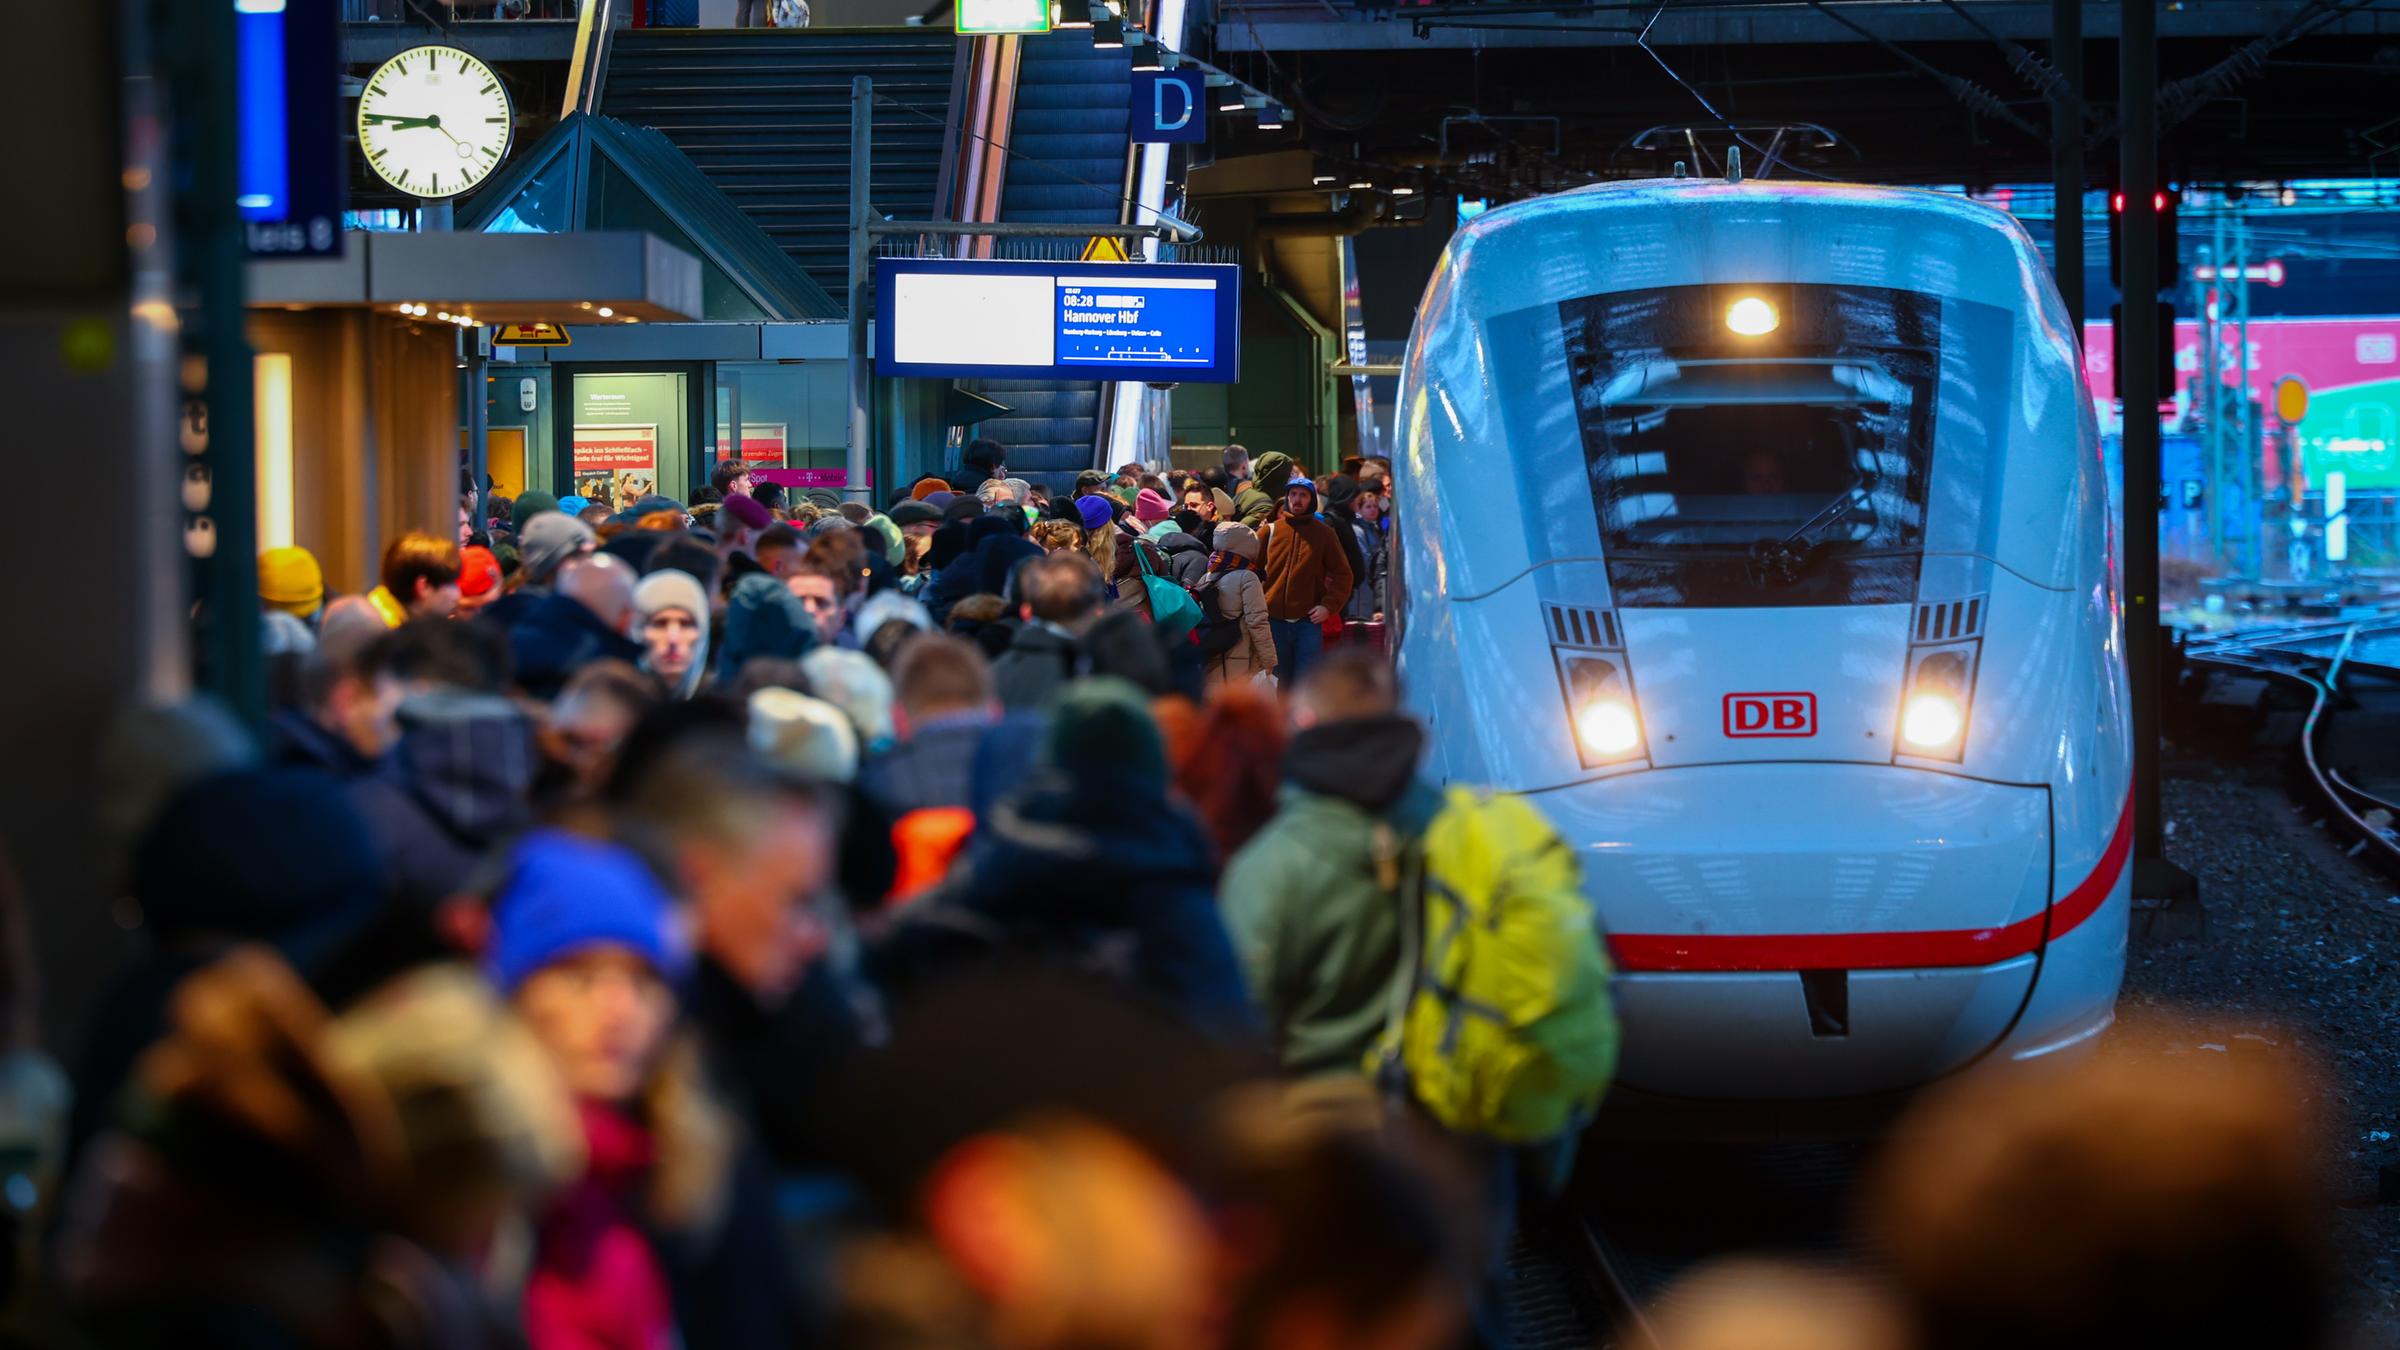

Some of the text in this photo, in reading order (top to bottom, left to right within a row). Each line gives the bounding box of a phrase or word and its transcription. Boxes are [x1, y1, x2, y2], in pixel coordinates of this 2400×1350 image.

[1154, 78, 1193, 130] D
[245, 221, 305, 252] leis
[1063, 295, 1094, 306] 08:28
[1063, 310, 1139, 323] Hannover Hbf
[750, 473, 768, 484] Spot
[1734, 698, 1808, 731] DB
